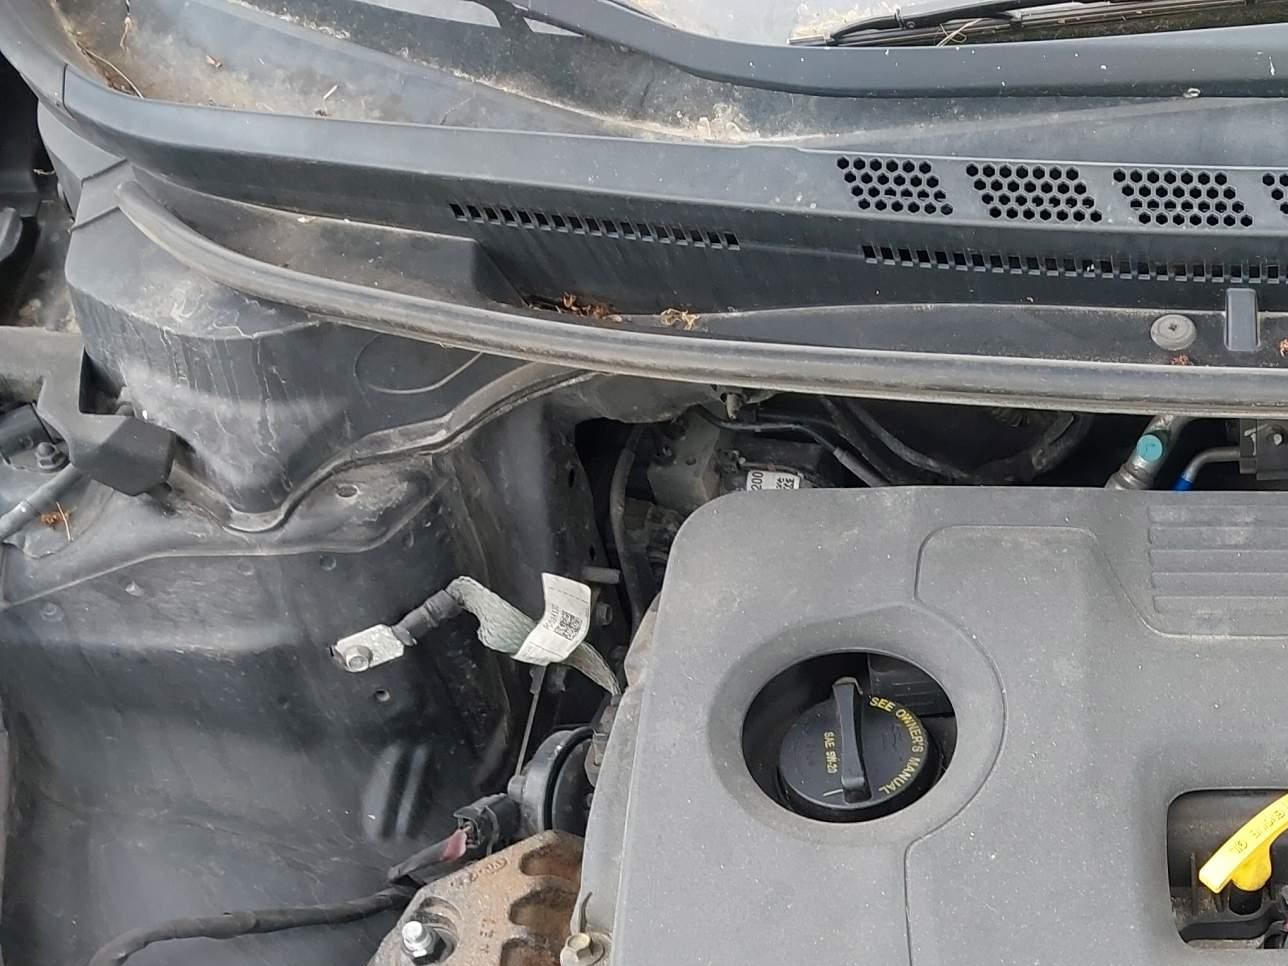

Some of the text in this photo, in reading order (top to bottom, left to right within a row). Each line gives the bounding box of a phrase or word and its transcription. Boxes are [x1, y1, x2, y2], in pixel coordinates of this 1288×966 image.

[869, 697, 925, 794] SEE OWNER'S MANUAL
